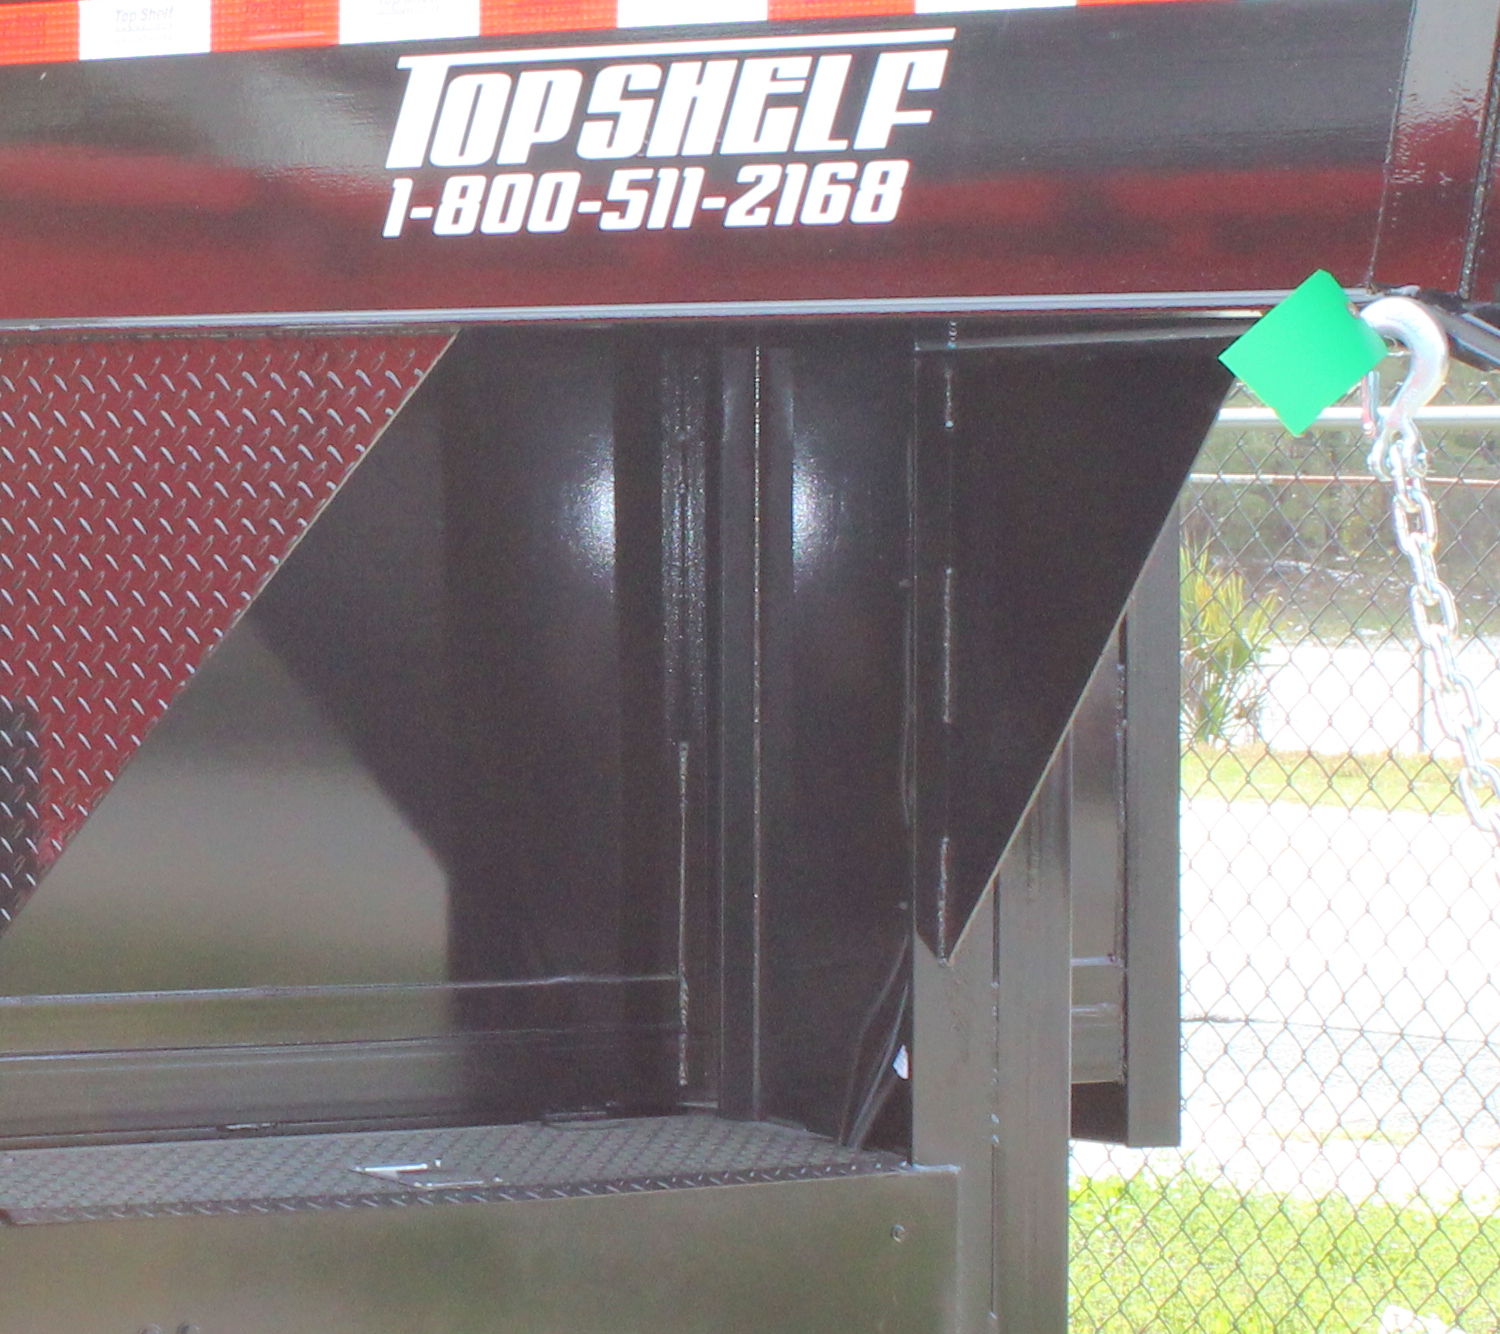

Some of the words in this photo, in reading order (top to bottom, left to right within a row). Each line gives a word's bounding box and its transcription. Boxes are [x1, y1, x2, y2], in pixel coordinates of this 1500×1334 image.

[115, 8, 137, 28] Top
[140, 6, 174, 22] Shelf
[383, 159, 911, 238] 1-800-511-2168
